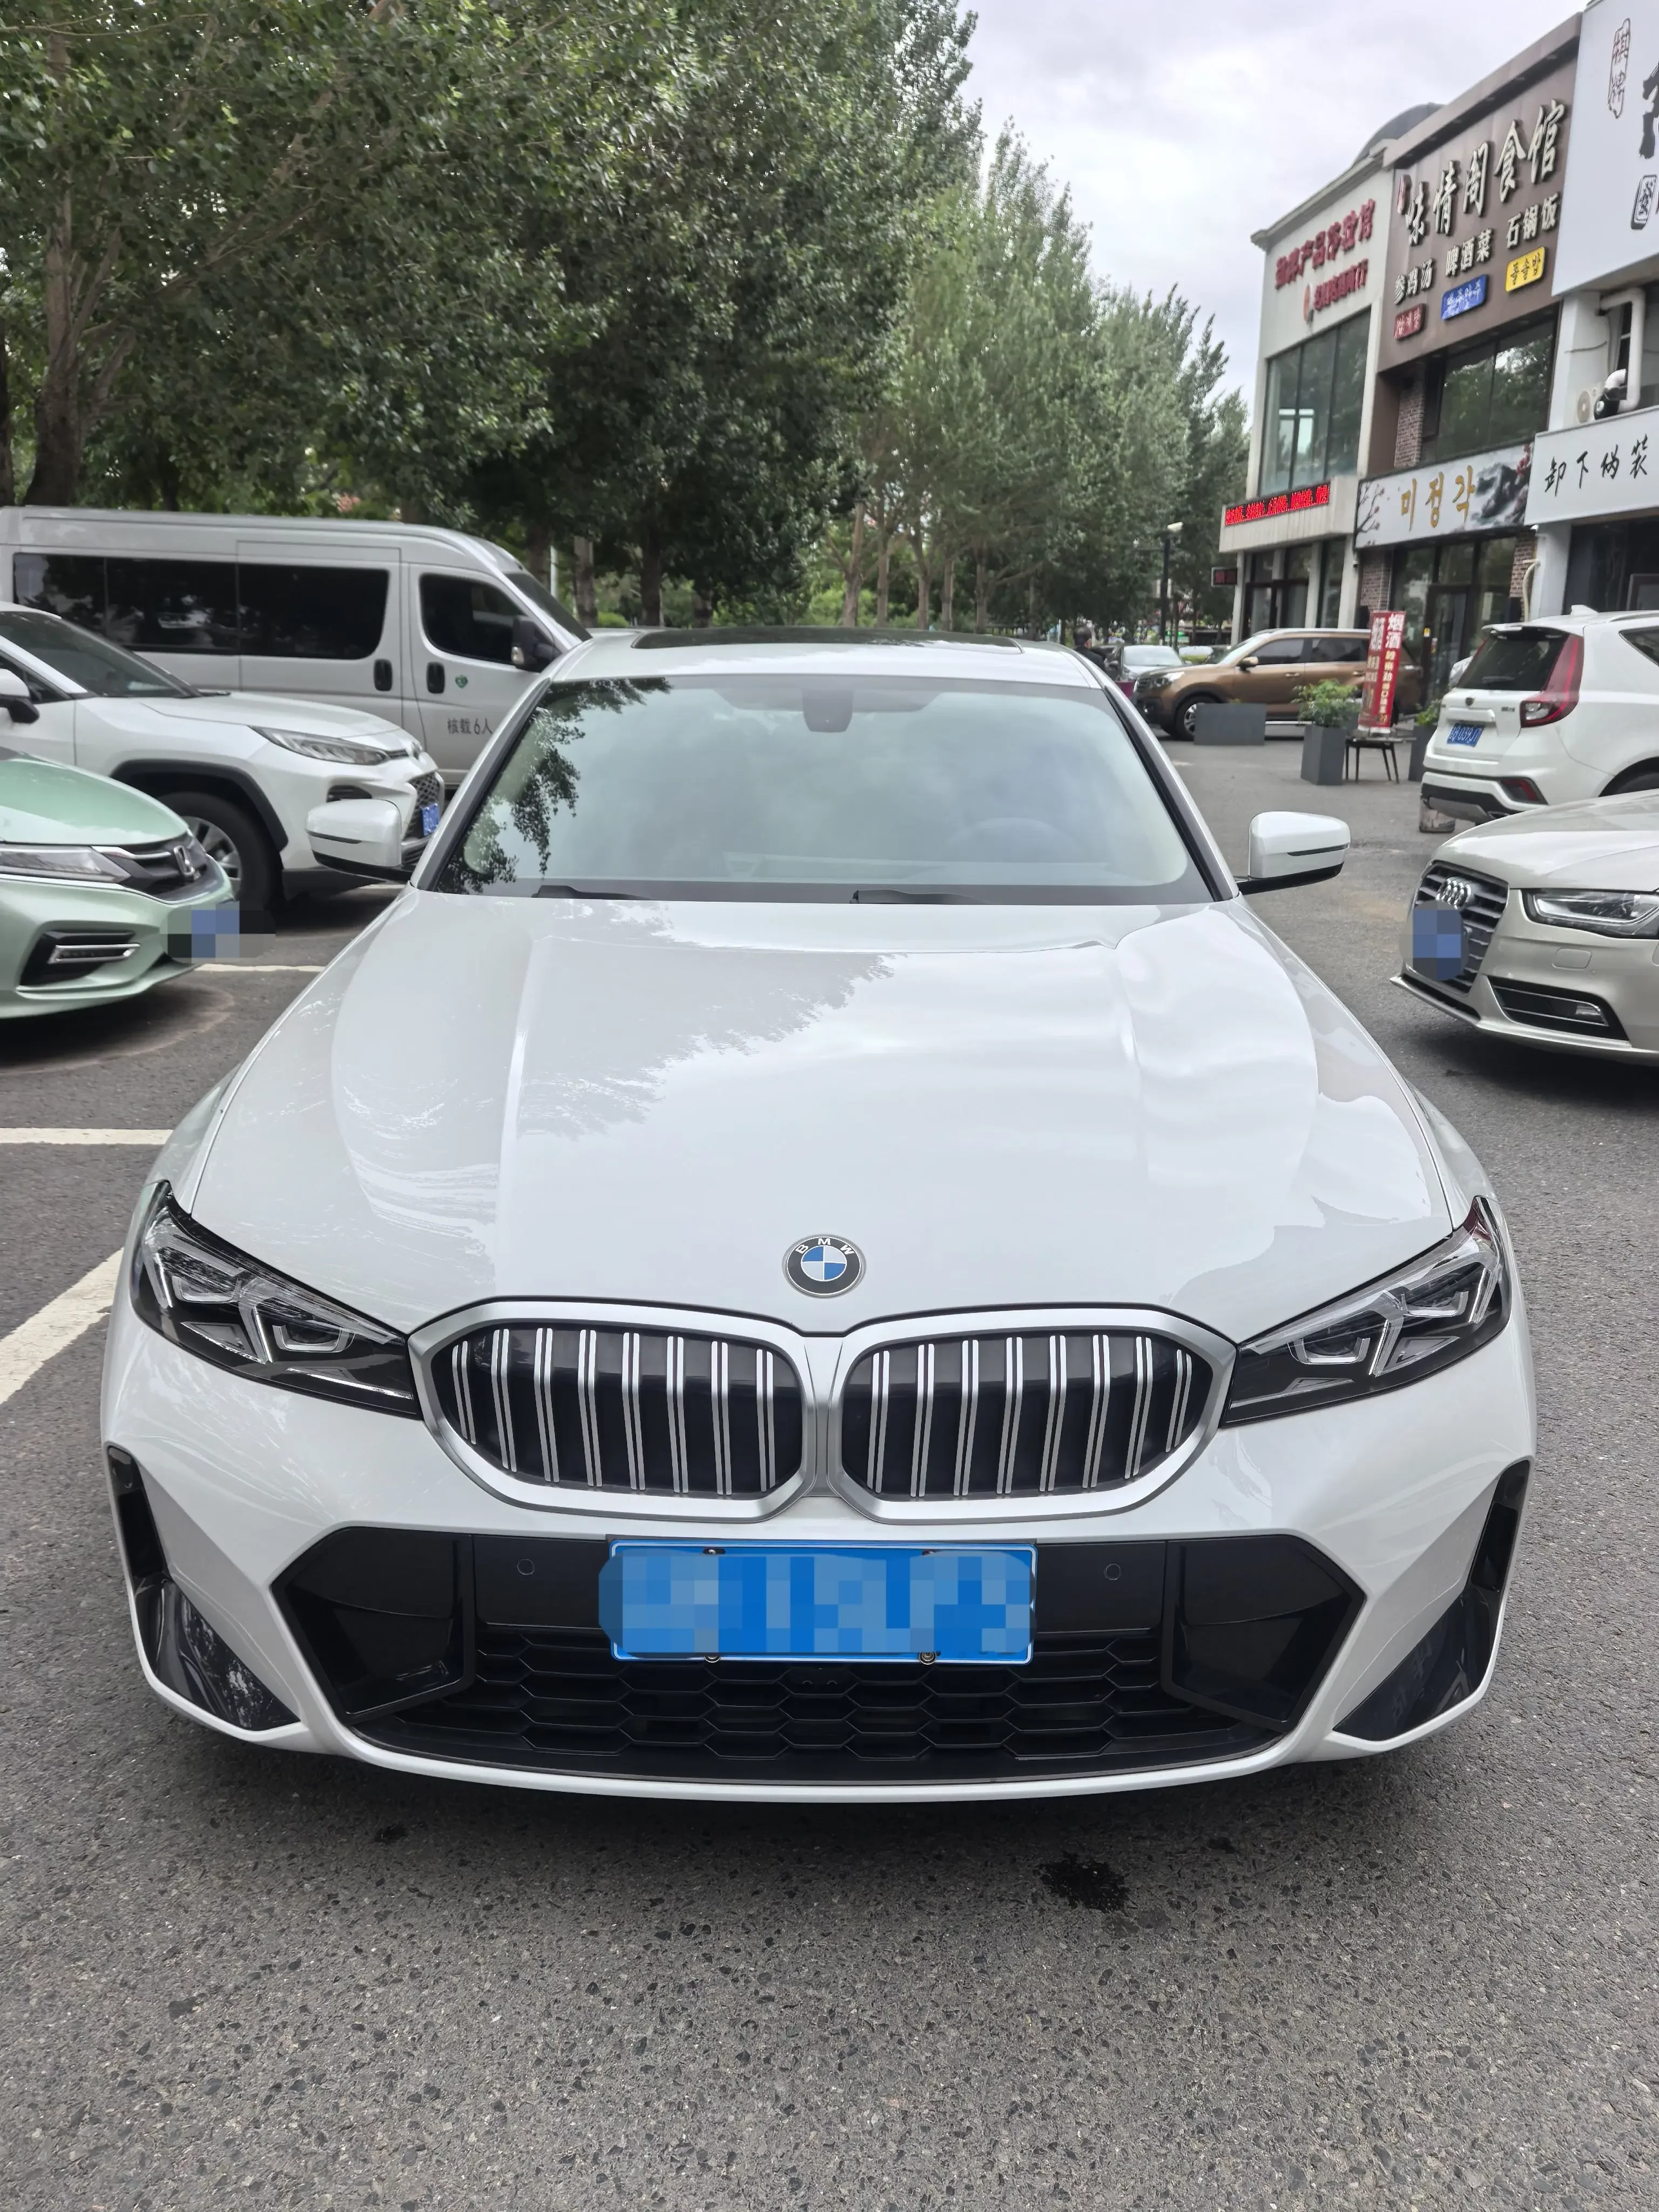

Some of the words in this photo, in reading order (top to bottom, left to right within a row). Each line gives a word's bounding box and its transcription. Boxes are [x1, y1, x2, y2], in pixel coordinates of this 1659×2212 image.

[1445, 228, 1492, 277] 啤酒菜
[1506, 192, 1559, 248] 石锅饭
[1401, 464, 1475, 531] 미정각
[1545, 433, 1648, 497] 卸下伪装
[795, 1238, 854, 1255] BMW
